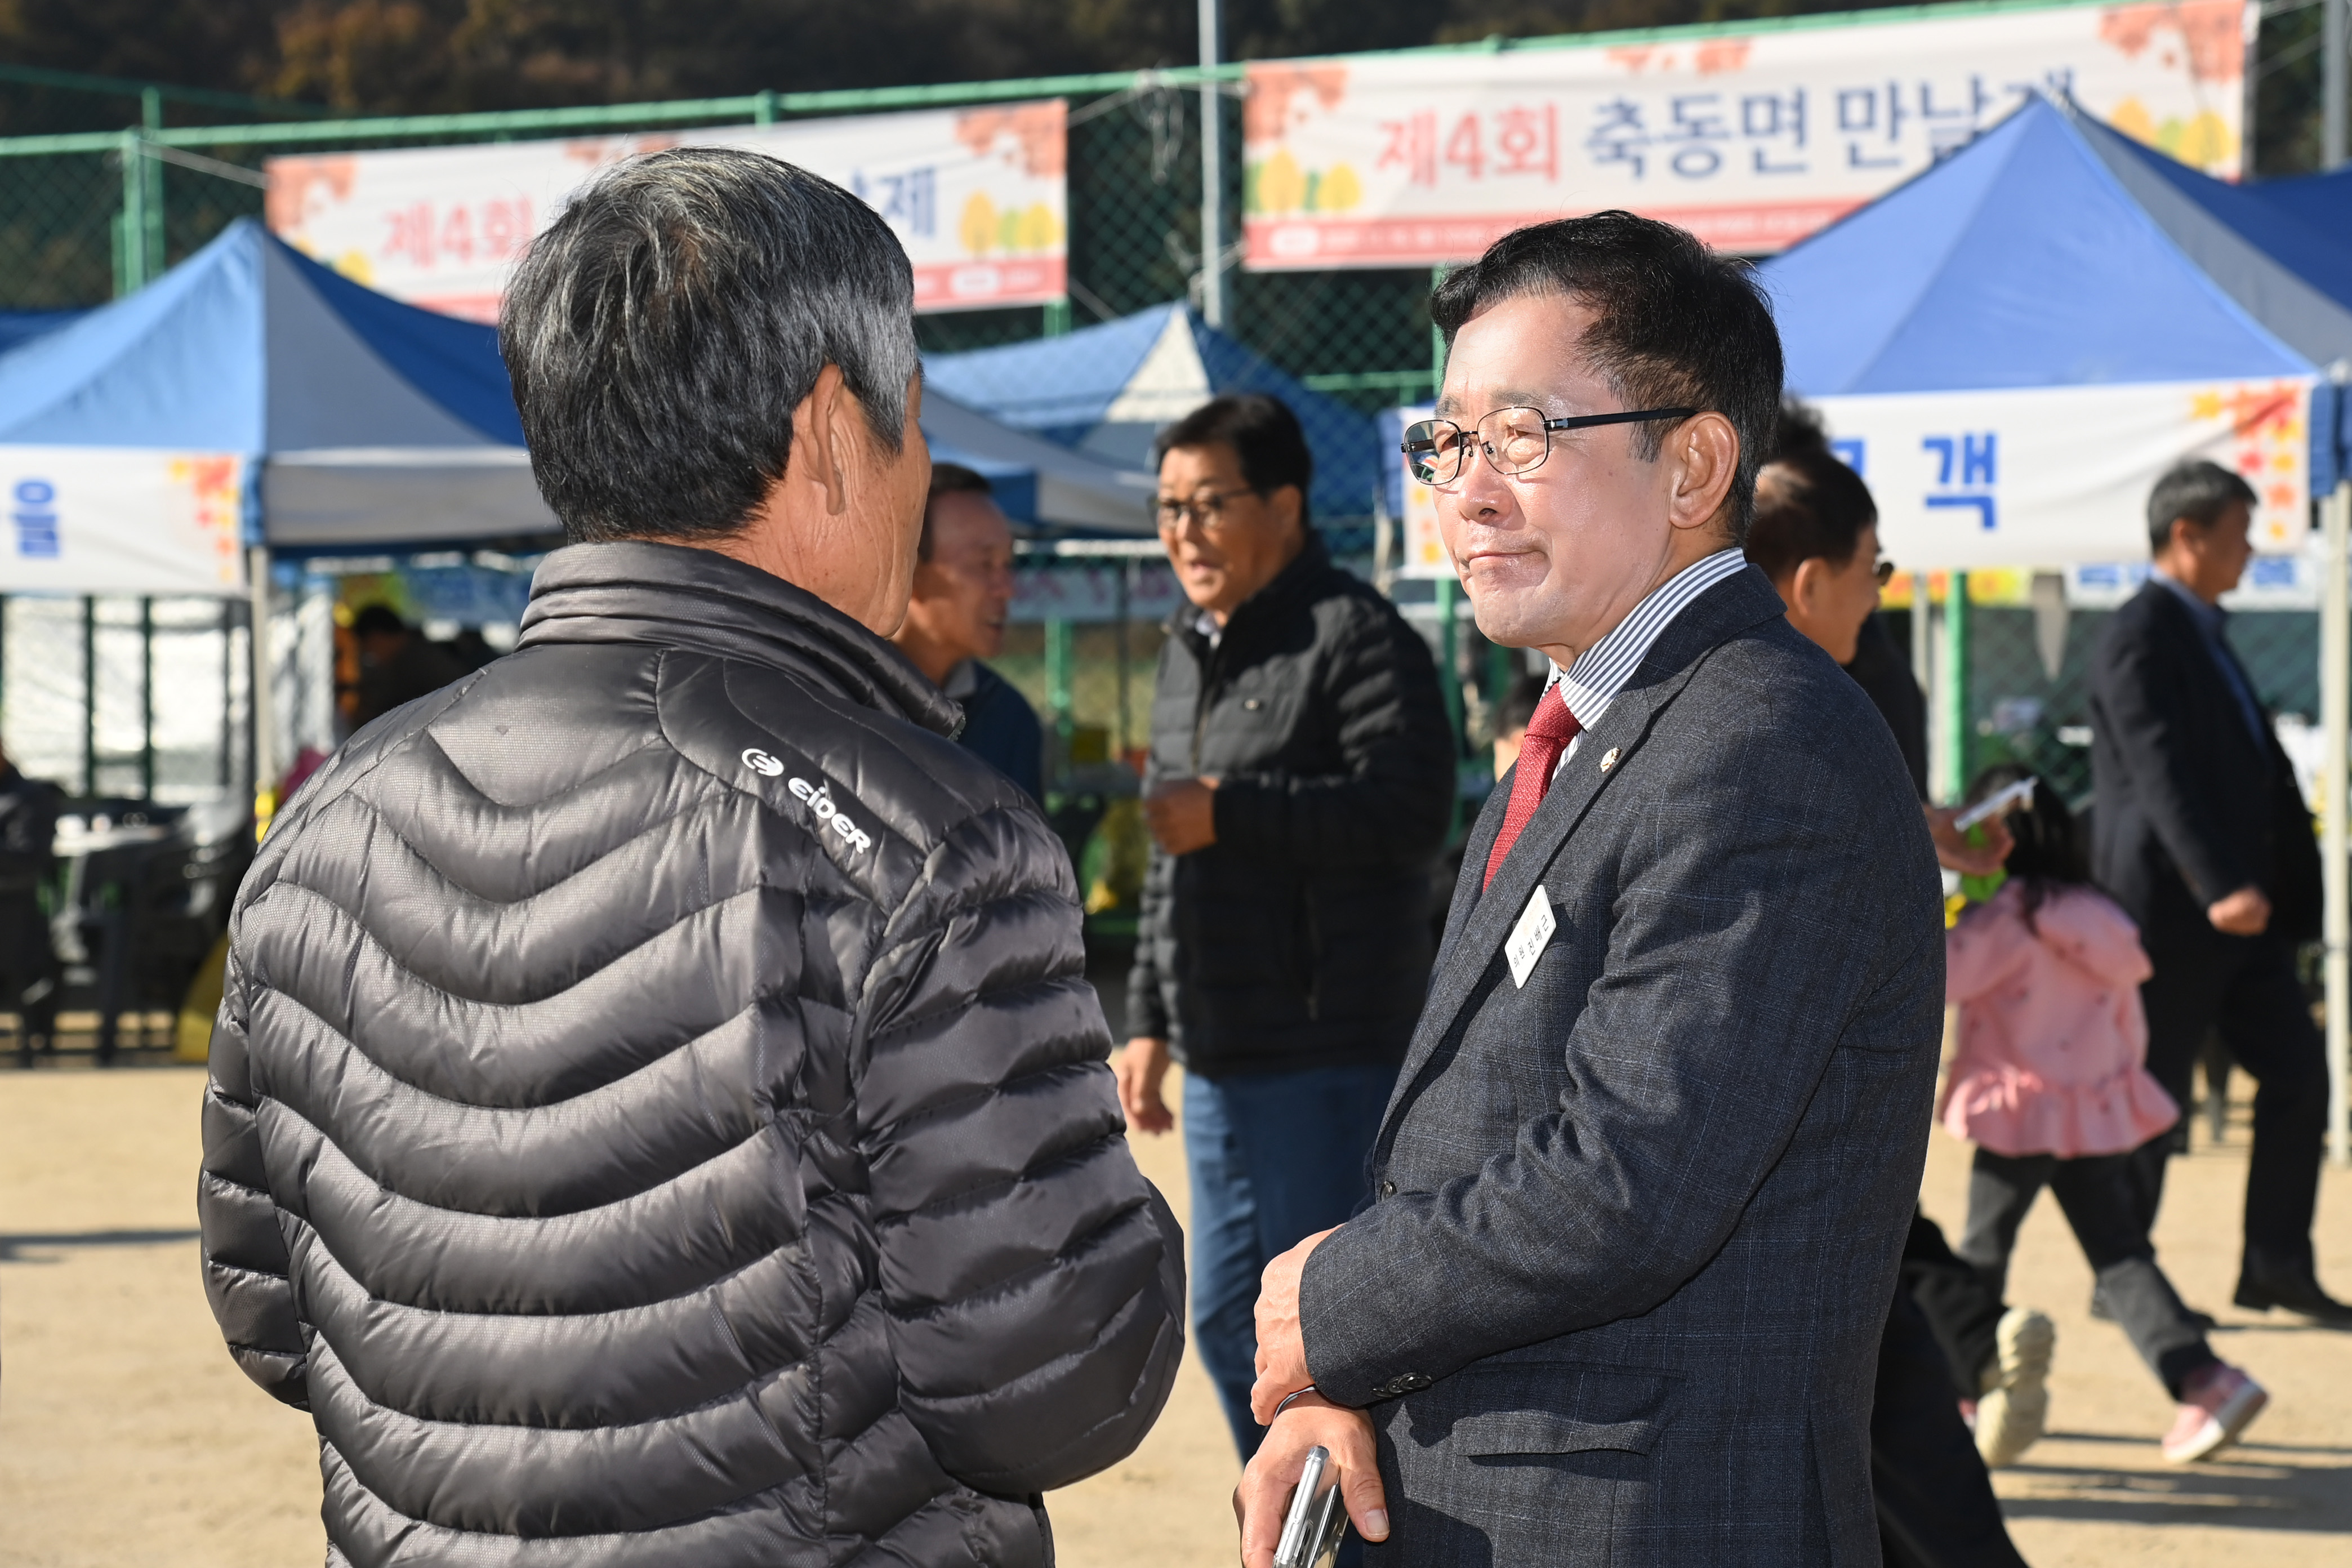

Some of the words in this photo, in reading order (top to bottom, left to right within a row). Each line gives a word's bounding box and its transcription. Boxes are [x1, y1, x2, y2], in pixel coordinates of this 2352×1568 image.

[1376, 98, 1561, 189] 제4회
[1585, 83, 1809, 180] 축동면
[378, 197, 533, 269] 제4회
[1513, 945, 1525, 968] 의원
